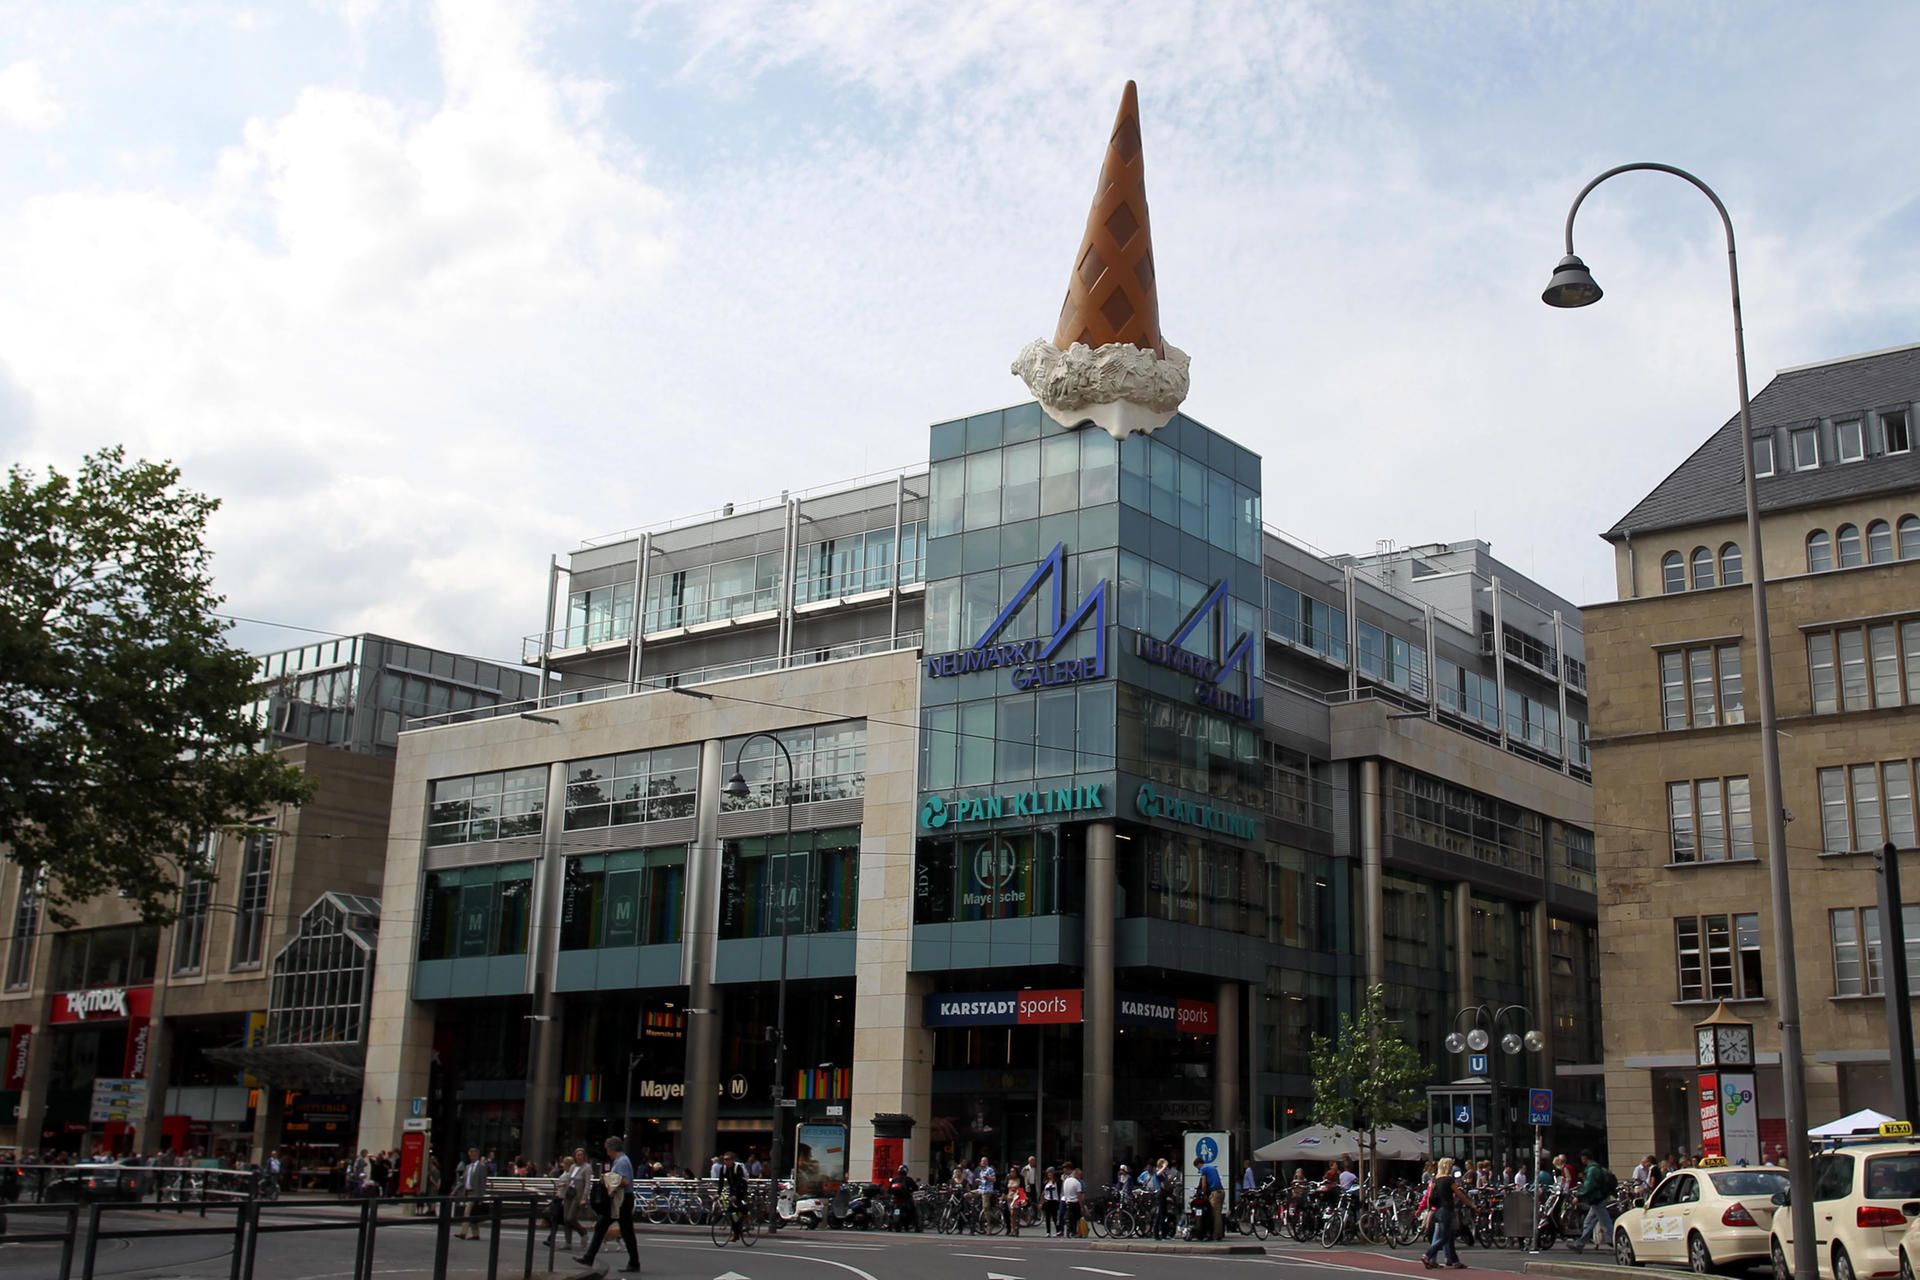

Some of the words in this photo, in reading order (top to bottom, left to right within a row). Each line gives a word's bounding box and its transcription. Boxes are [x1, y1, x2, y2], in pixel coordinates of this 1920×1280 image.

[928, 638, 1042, 678] NEUMARKT
[1010, 656, 1097, 691] GALERIE
[957, 796, 1003, 823] PAN
[1014, 783, 1104, 817] KLINIK
[1163, 795, 1197, 826] PAN
[1201, 805, 1259, 841] KLINIK
[917, 863, 930, 897] EDV
[940, 1000, 1016, 1016] KARSTADT
[1020, 995, 1067, 1016] sports
[1121, 1000, 1175, 1020] KARSTADT
[1177, 1006, 1208, 1025] sports
[1473, 1058, 1484, 1071] U
[411, 1099, 421, 1113] U
[1510, 1107, 1518, 1122] U
[1531, 1113, 1550, 1123] TAXI
[1887, 1123, 1910, 1134] TAXI
[1705, 1158, 1725, 1167] TAXI
